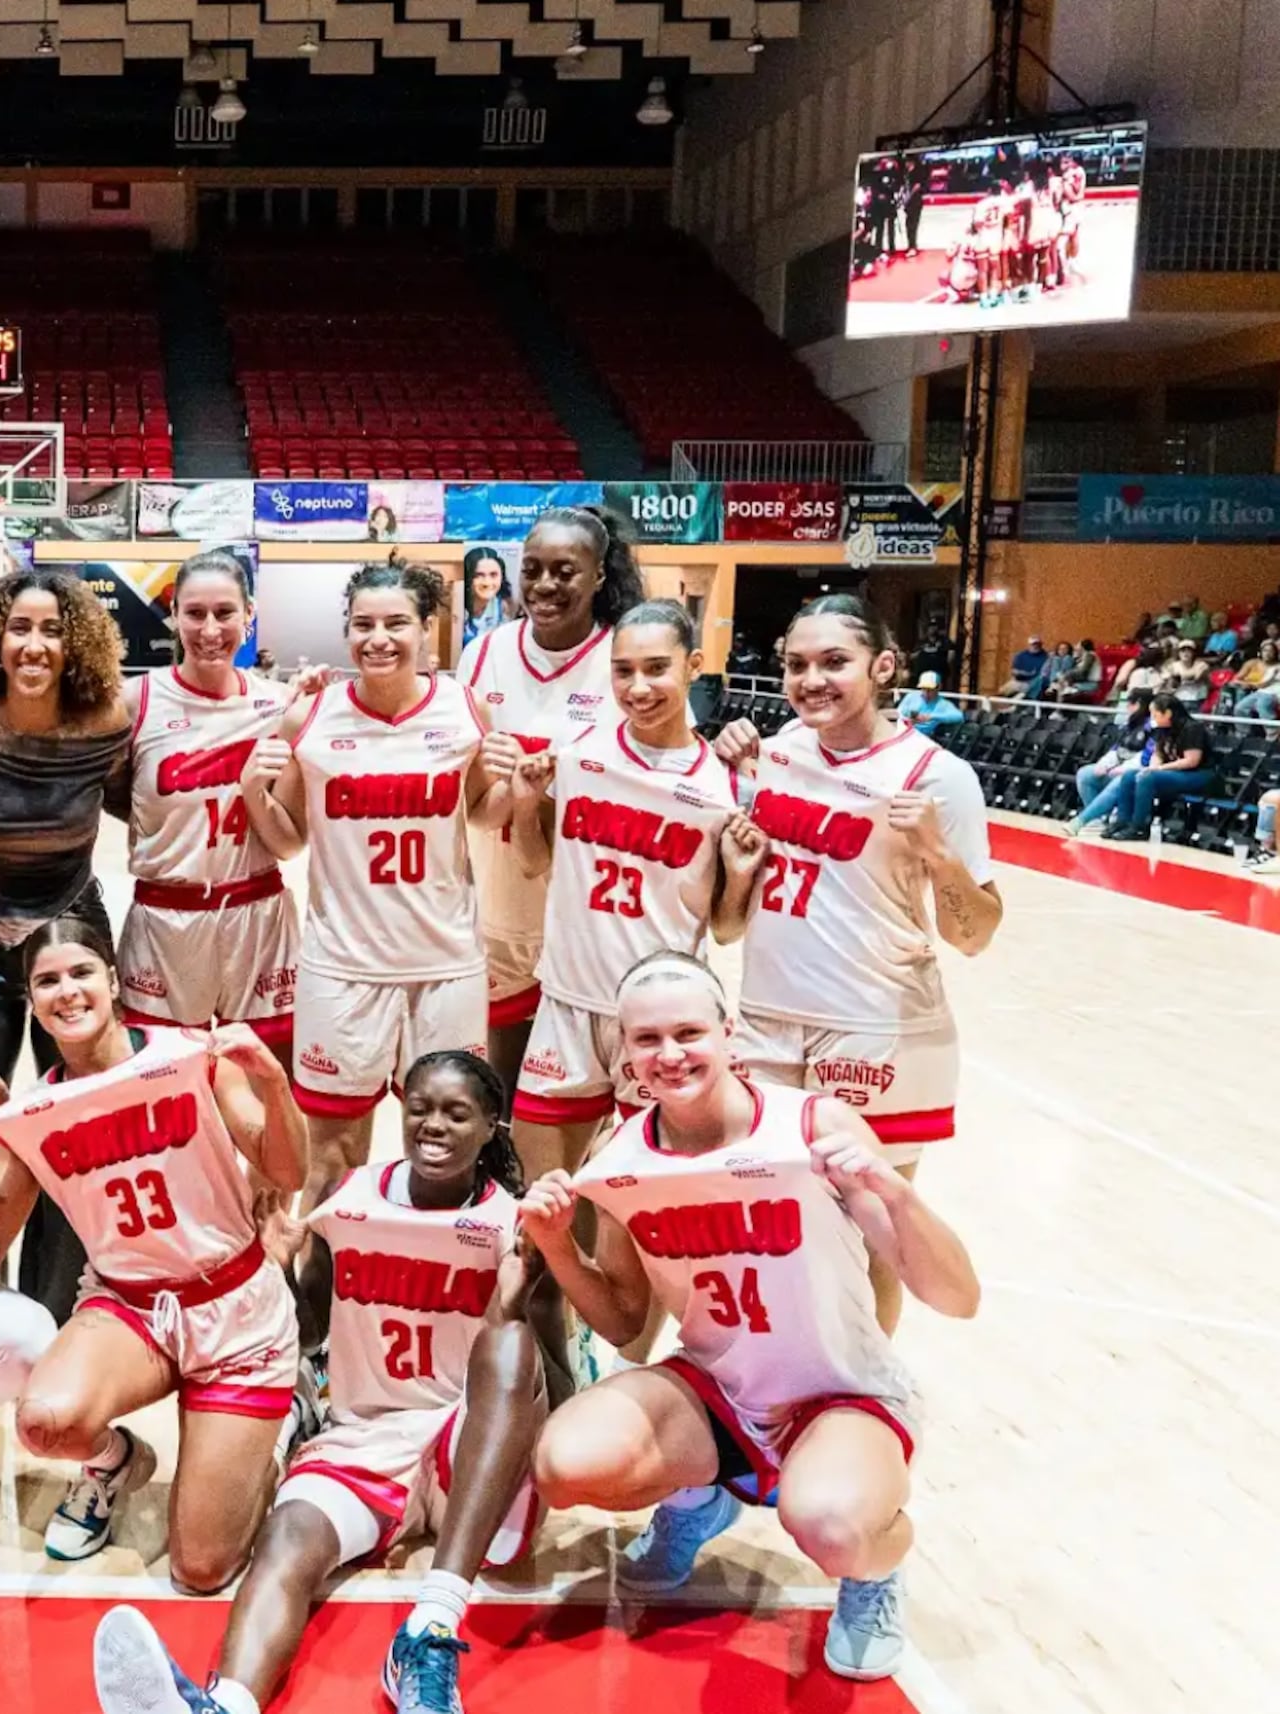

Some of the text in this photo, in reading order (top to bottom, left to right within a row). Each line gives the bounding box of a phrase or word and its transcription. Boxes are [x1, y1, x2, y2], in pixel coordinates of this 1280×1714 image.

[294, 497, 355, 514] neptuno
[491, 503, 539, 515] Walmart
[630, 494, 698, 521] 1800
[644, 523, 684, 532] TEQUILA
[1094, 496, 1275, 527] Puerto Rico
[877, 537, 933, 555] ideas
[205, 795, 248, 850] 14
[367, 829, 426, 885] 20
[588, 859, 645, 919] 23
[761, 854, 821, 919] 27
[814, 1059, 896, 1095] GIGANTES
[104, 1169, 178, 1239] 33
[692, 1267, 772, 1333] 34
[380, 1318, 436, 1381] 21
